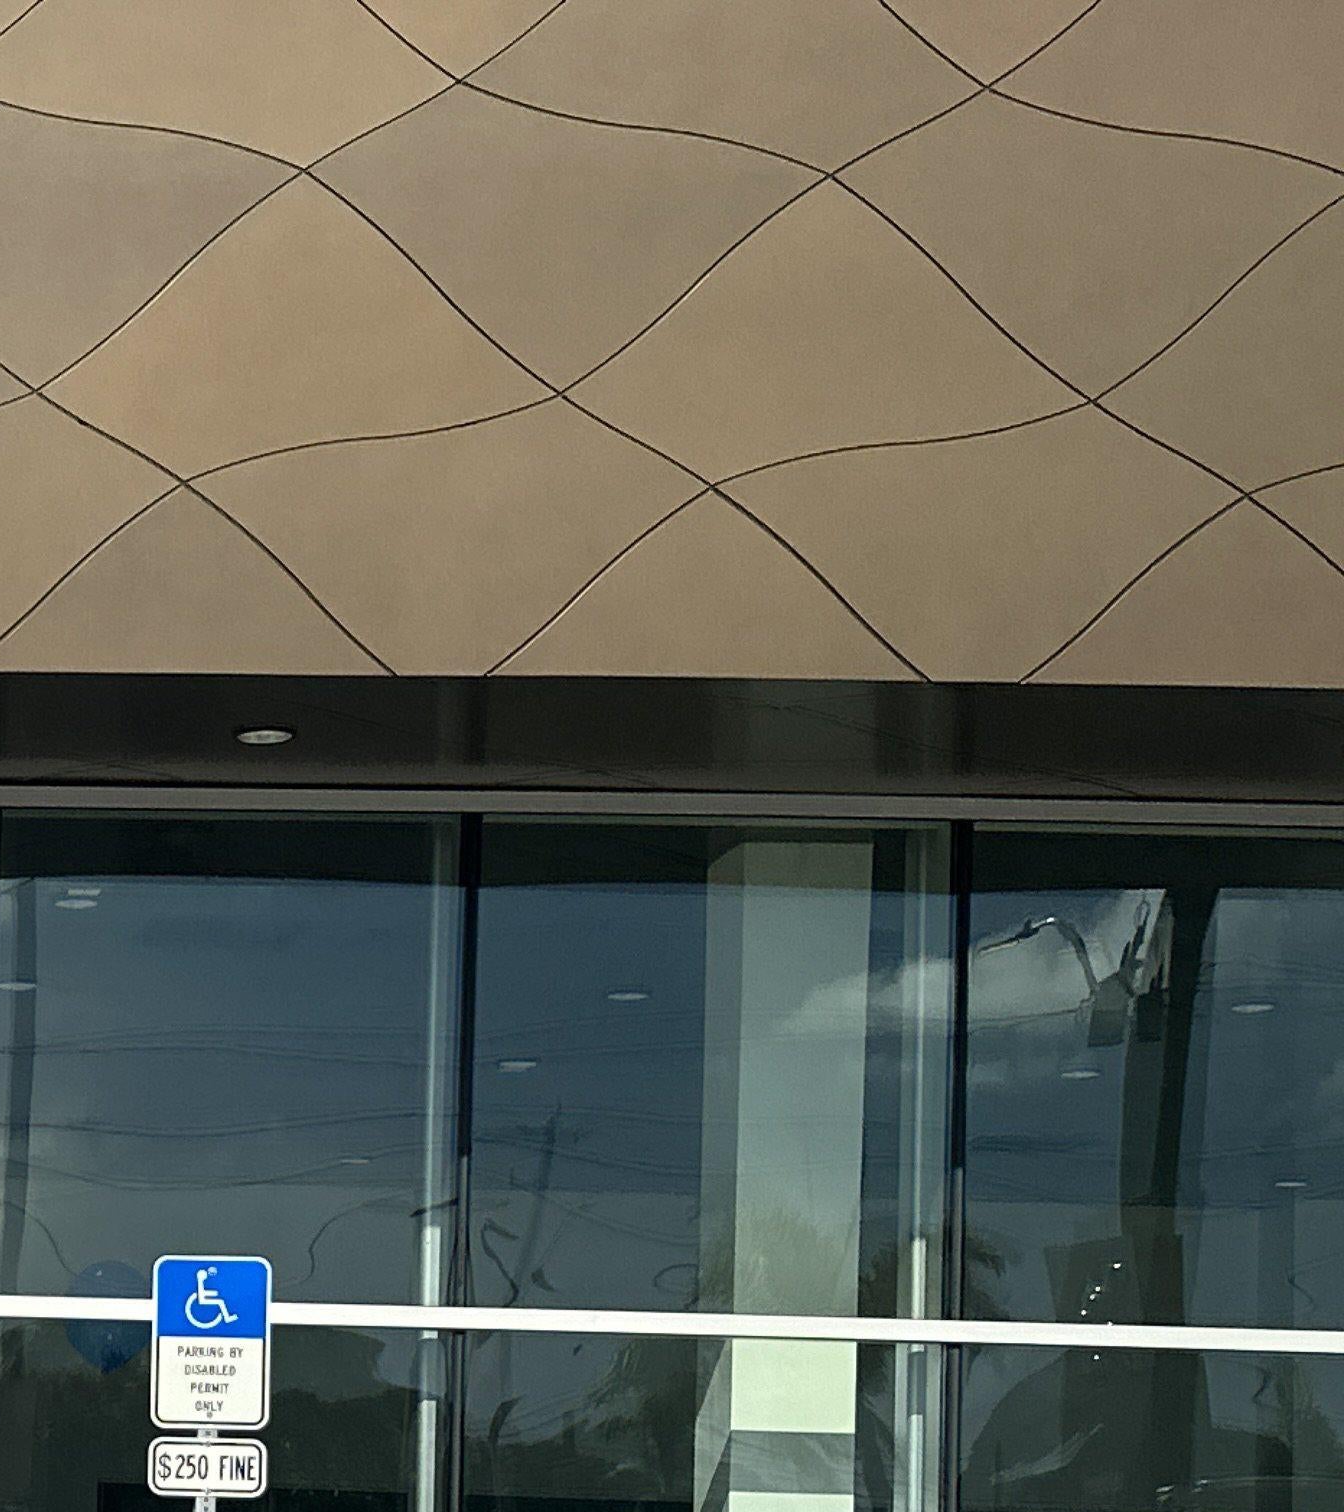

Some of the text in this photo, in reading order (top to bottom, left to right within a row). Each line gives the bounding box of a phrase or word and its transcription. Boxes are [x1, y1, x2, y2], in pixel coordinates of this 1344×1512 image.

[177, 1345, 244, 1359] PARKING BY
[184, 1364, 236, 1377] DISABLED
[190, 1382, 229, 1395] PERMIT
[195, 1400, 224, 1413] ONLY
[157, 1452, 257, 1482] $250 FINE
